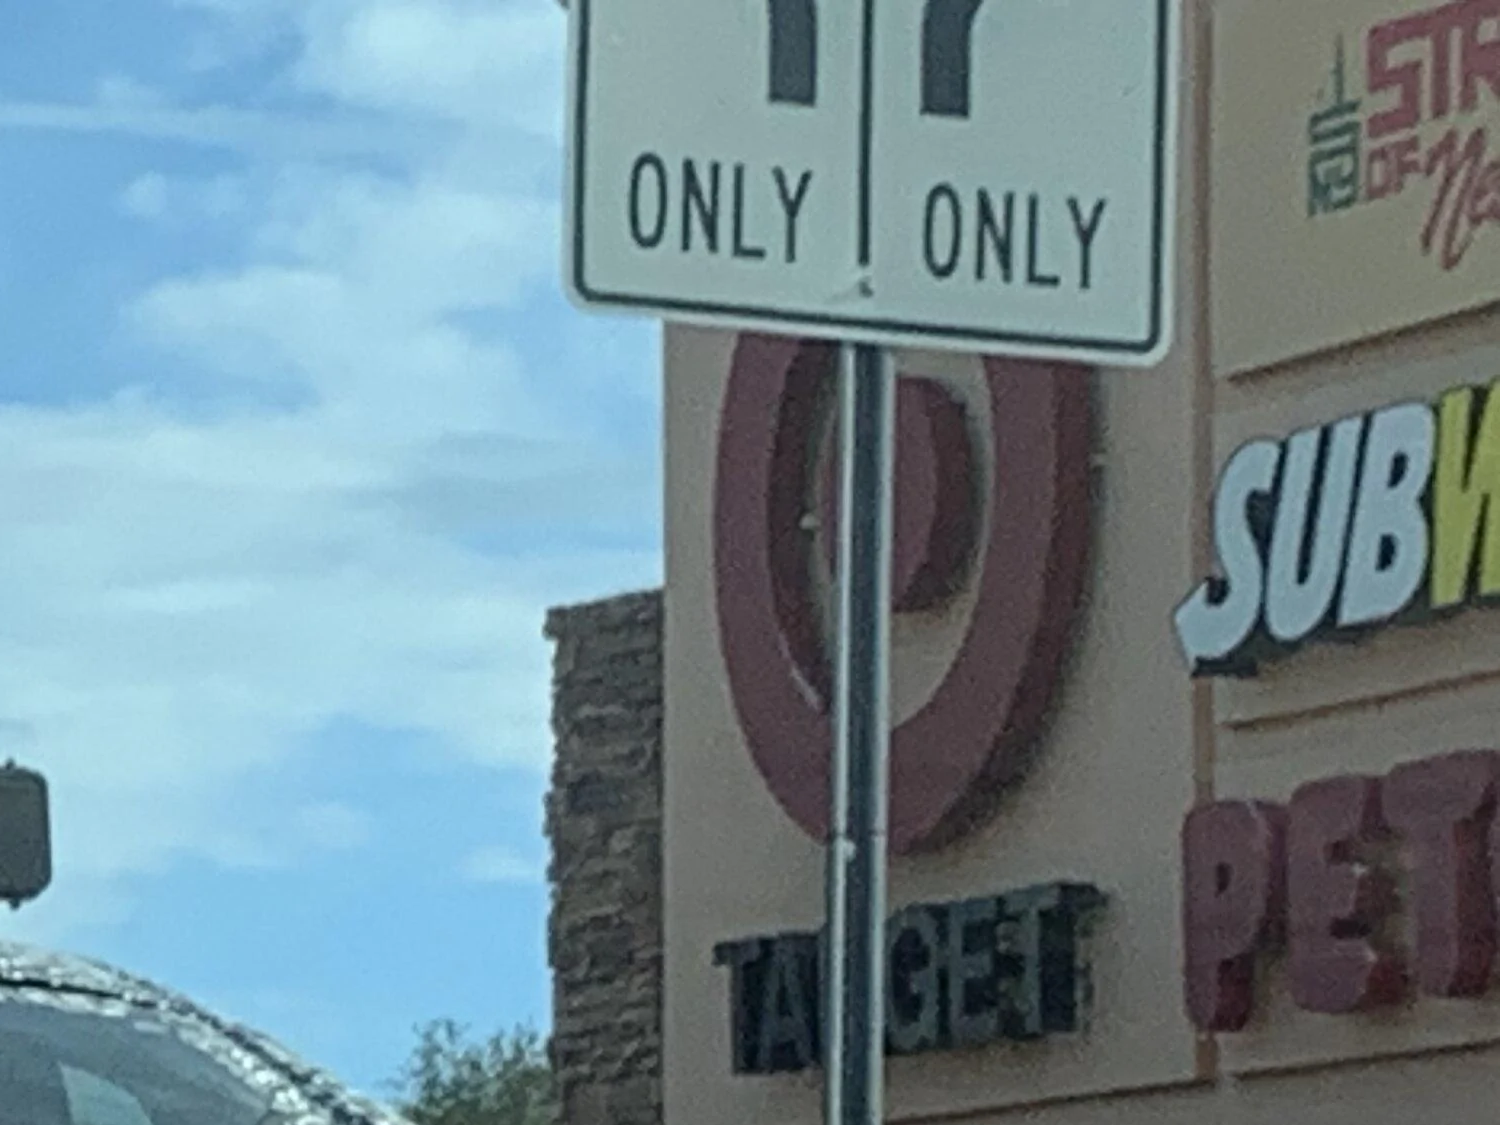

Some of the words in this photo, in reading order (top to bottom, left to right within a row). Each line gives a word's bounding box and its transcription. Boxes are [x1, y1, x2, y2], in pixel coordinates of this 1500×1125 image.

[628, 151, 813, 264] ONLY
[1367, 134, 1420, 202] OF
[922, 182, 1107, 290] ONLY
[1182, 749, 1500, 1032] PET
[713, 881, 1108, 1077] TAGET
